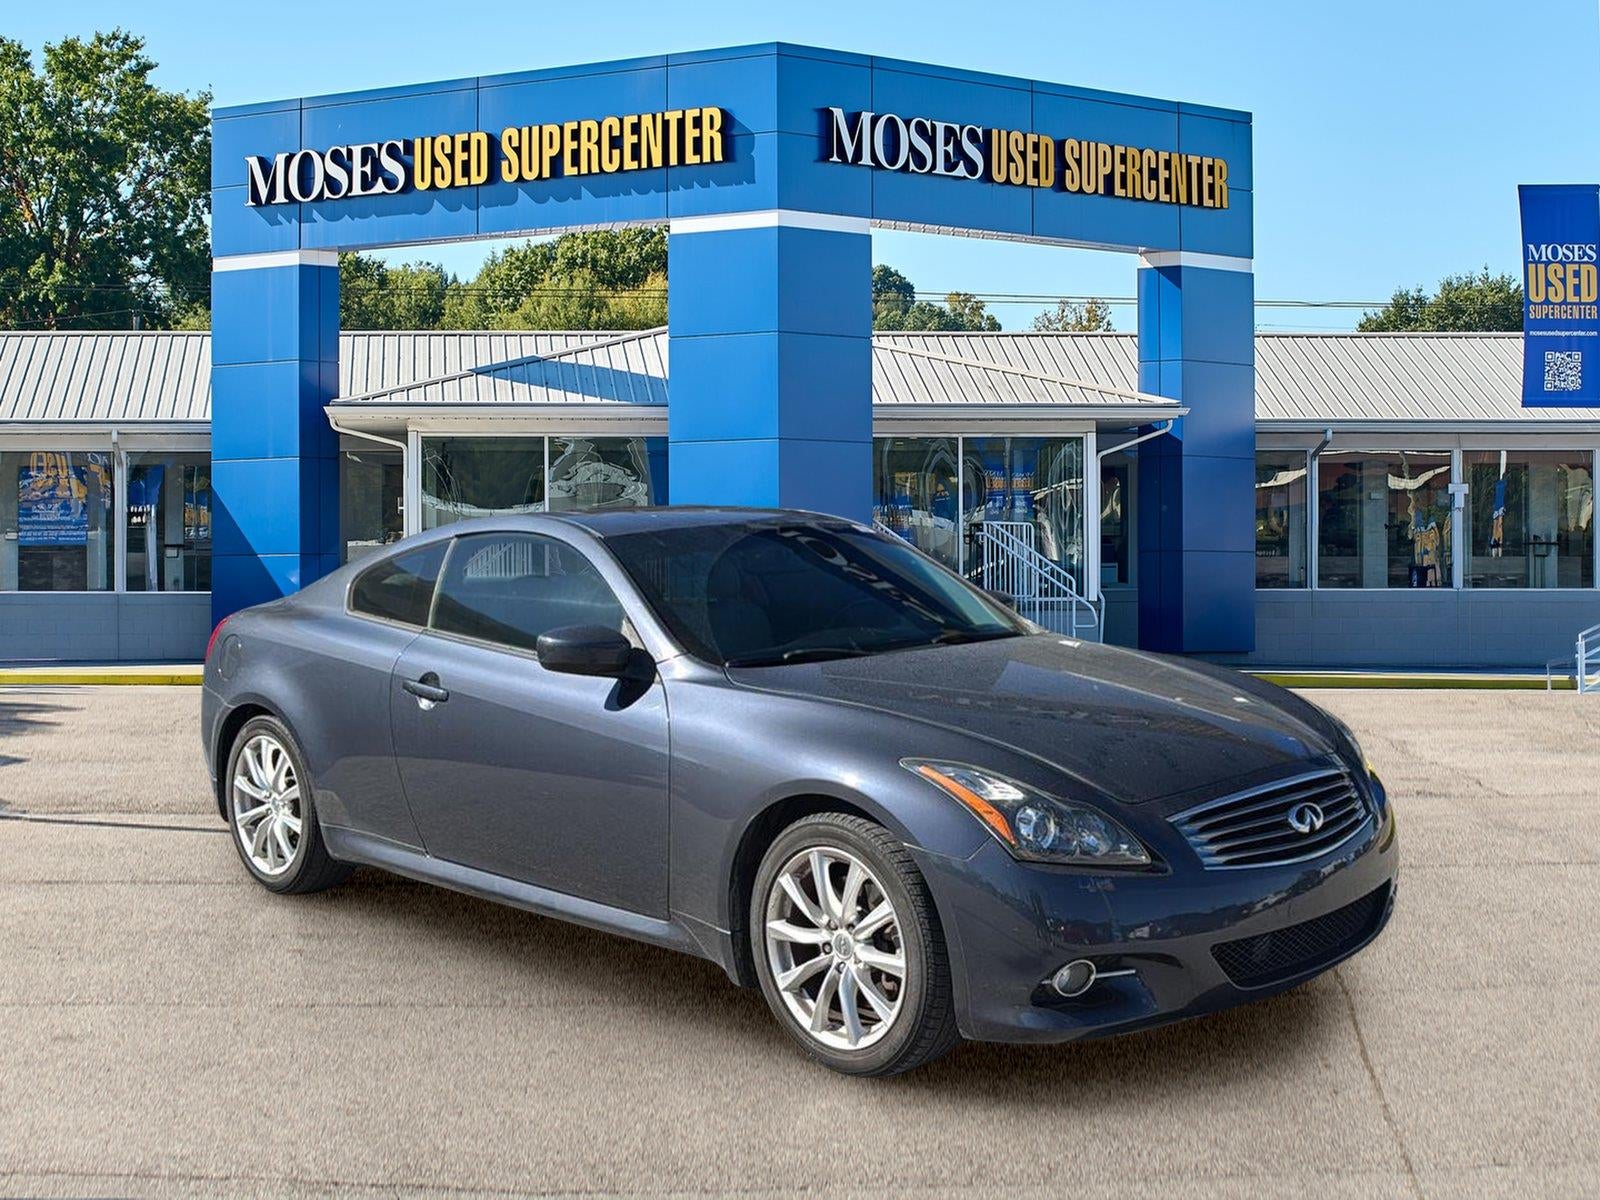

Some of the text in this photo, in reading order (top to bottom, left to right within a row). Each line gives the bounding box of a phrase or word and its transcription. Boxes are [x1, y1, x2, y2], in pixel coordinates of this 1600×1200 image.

[244, 105, 724, 207] MOSES USED SUPERCENTER
[828, 106, 1230, 209] MOSES USED SUPERCENTER
[1528, 244, 1597, 262] MOSES
[1528, 264, 1597, 302] USED
[1530, 304, 1598, 319] SUPERCENTER
[1530, 330, 1598, 338] mosesusedsupercenter.com
